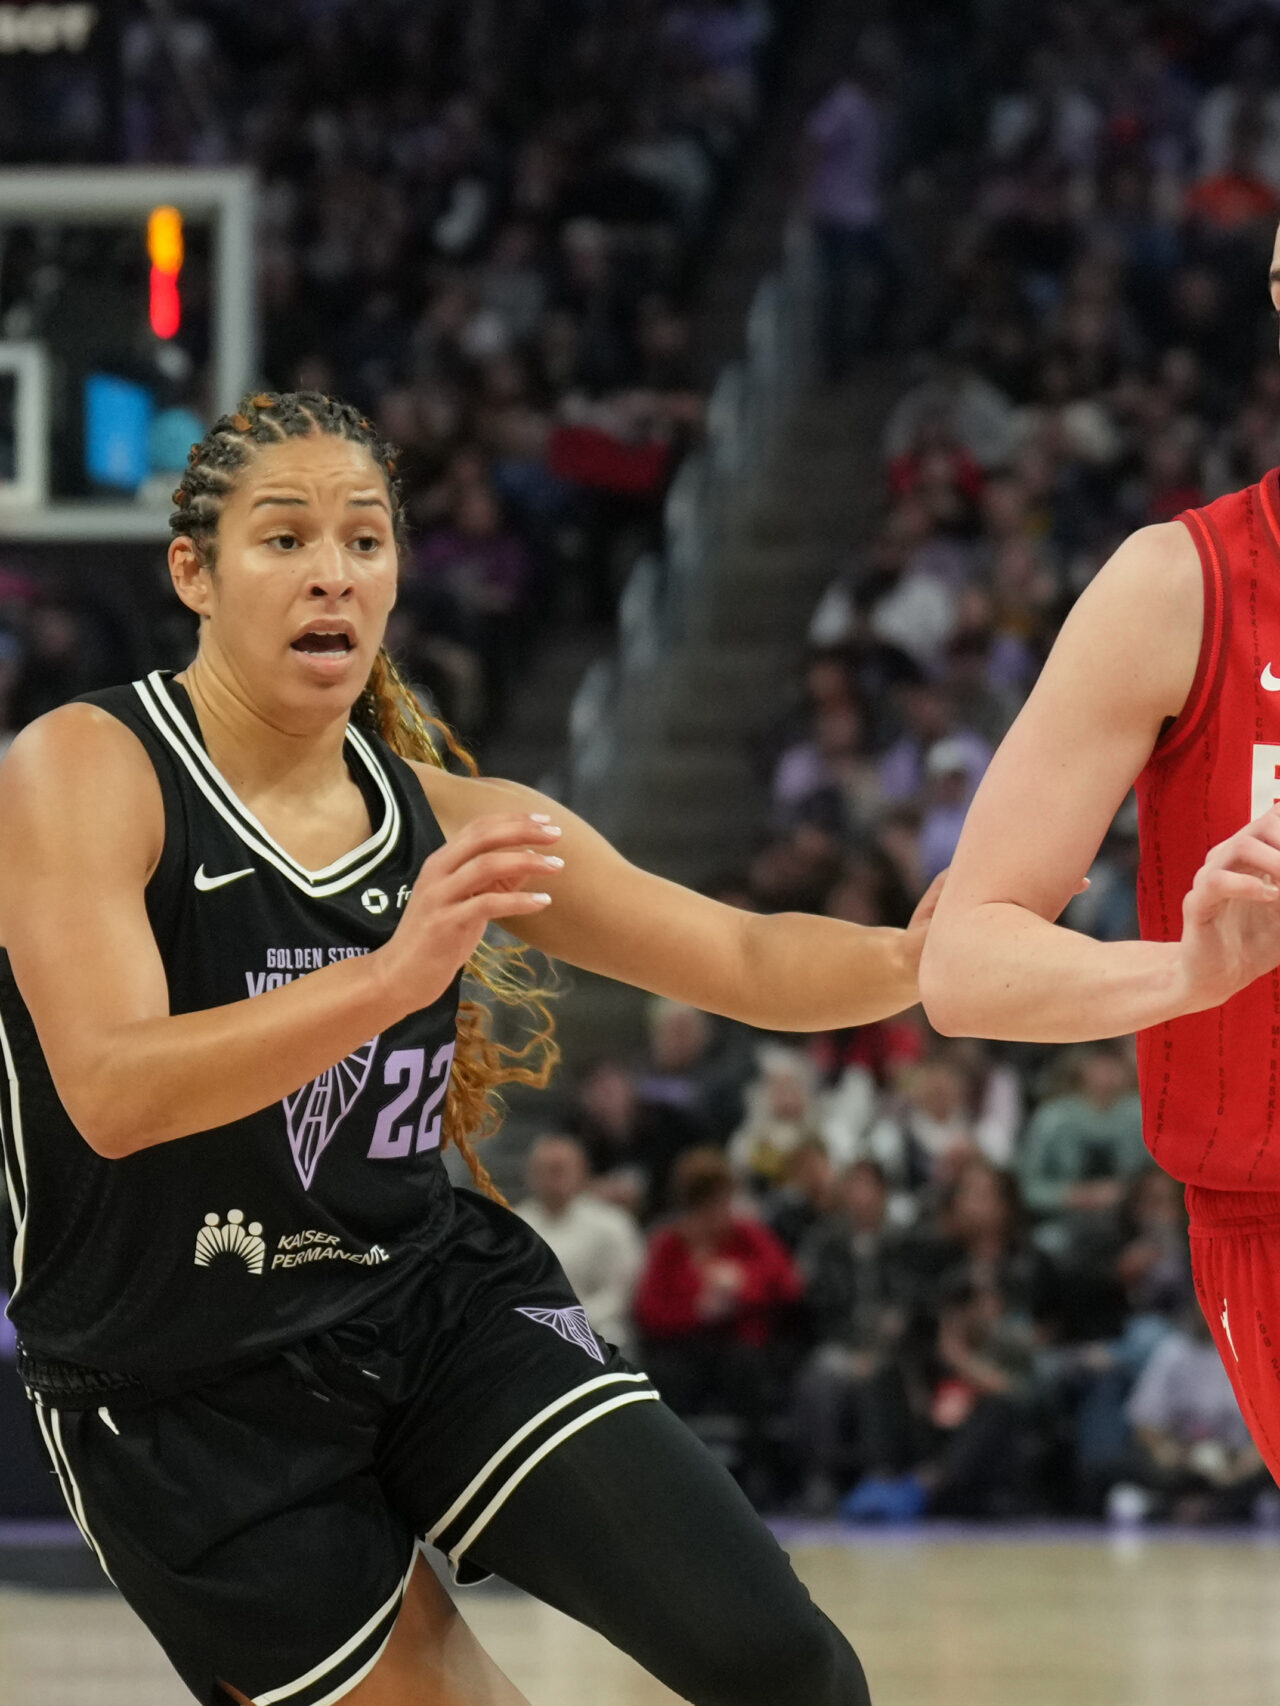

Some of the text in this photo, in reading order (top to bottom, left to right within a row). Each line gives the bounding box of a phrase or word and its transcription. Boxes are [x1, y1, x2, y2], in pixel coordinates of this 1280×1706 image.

[266, 948, 323, 969] GOLDEN
[366, 1041, 456, 1159] 22
[278, 1230, 341, 1249] KAISER
[271, 1244, 390, 1270] PERMANENTE
